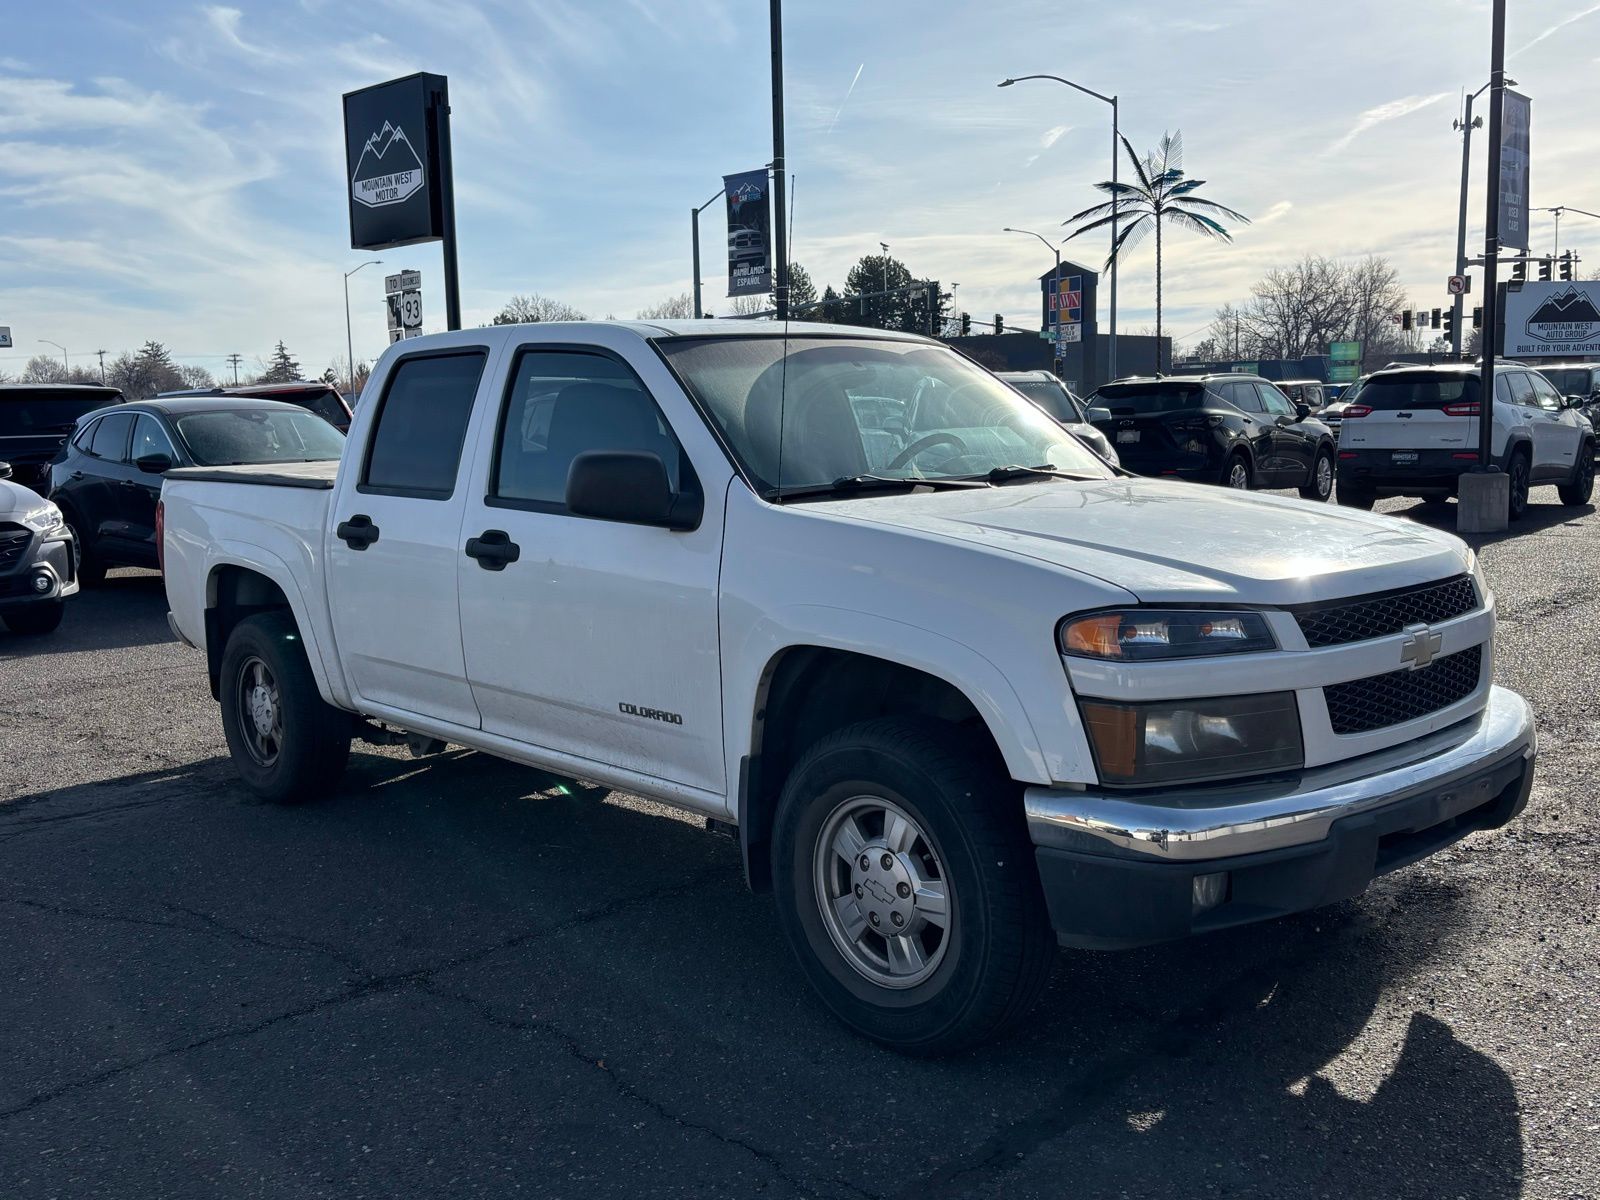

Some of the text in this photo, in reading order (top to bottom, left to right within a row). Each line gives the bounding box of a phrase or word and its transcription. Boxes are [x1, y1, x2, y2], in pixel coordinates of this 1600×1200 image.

[362, 172, 413, 192] MOUNTAIN WEST
[375, 187, 399, 201] MOTOR
[389, 279, 398, 290] TO
[405, 300, 420, 319] 93
[1537, 322, 1593, 332] MOUNTAIN WEST
[1564, 330, 1588, 338] GROUP
[1516, 345, 1535, 353] BUILT
[1552, 344, 1571, 352] YOUR
[618, 702, 683, 725] COLORADO
